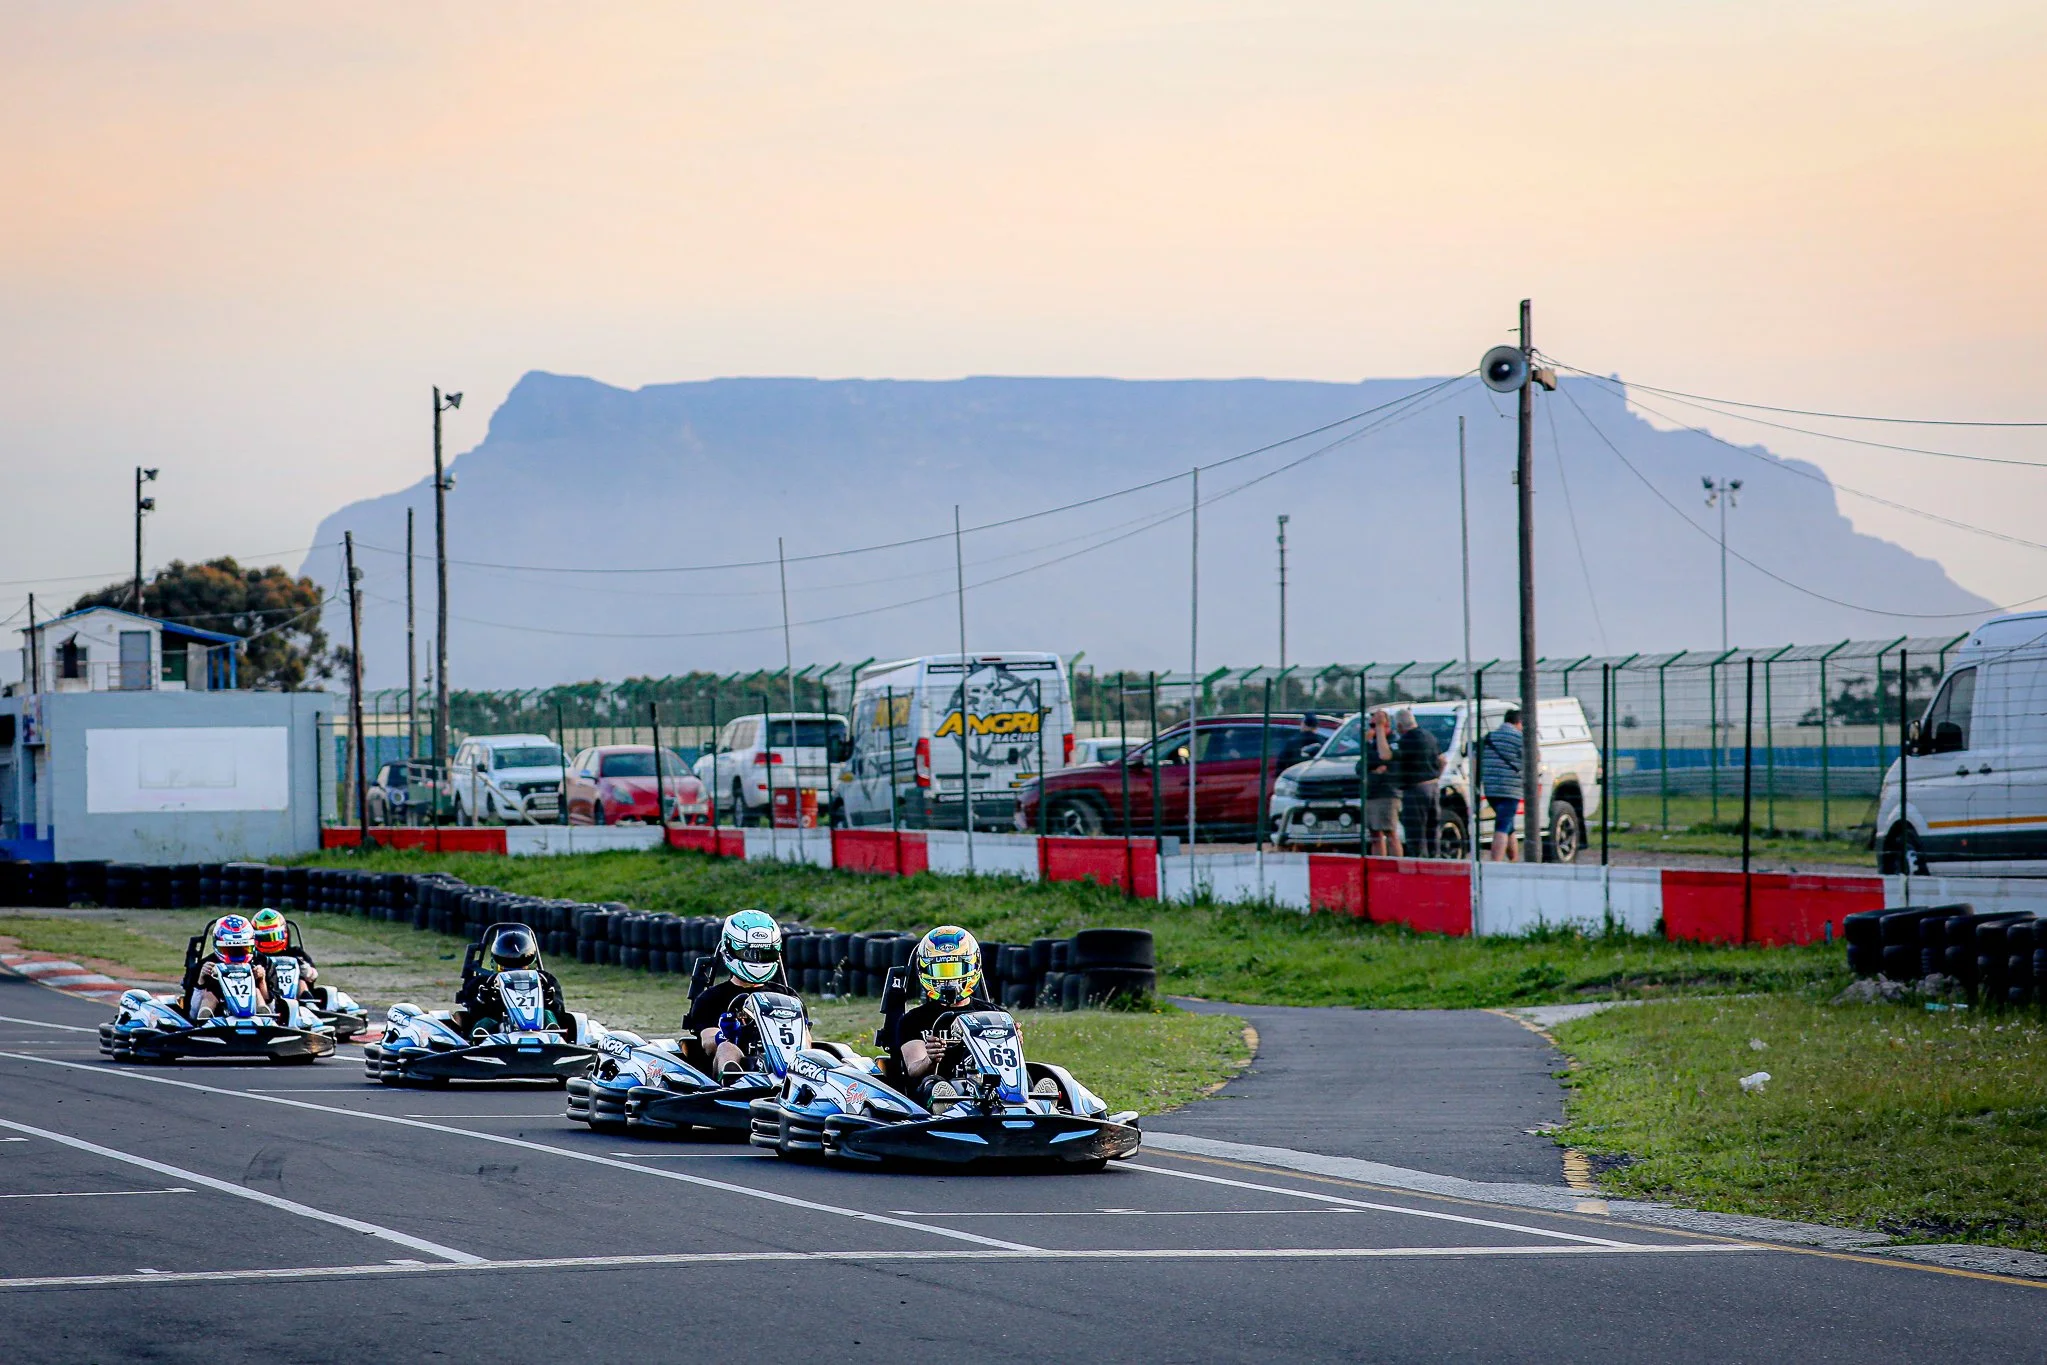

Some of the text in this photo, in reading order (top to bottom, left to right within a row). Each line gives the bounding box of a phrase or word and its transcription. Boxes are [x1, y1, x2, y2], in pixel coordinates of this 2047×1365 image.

[993, 732, 1040, 743] RACING
[231, 984, 250, 995] 12
[516, 996, 535, 1007] 27
[779, 1027, 795, 1046] 5
[988, 1047, 1018, 1068] 63
